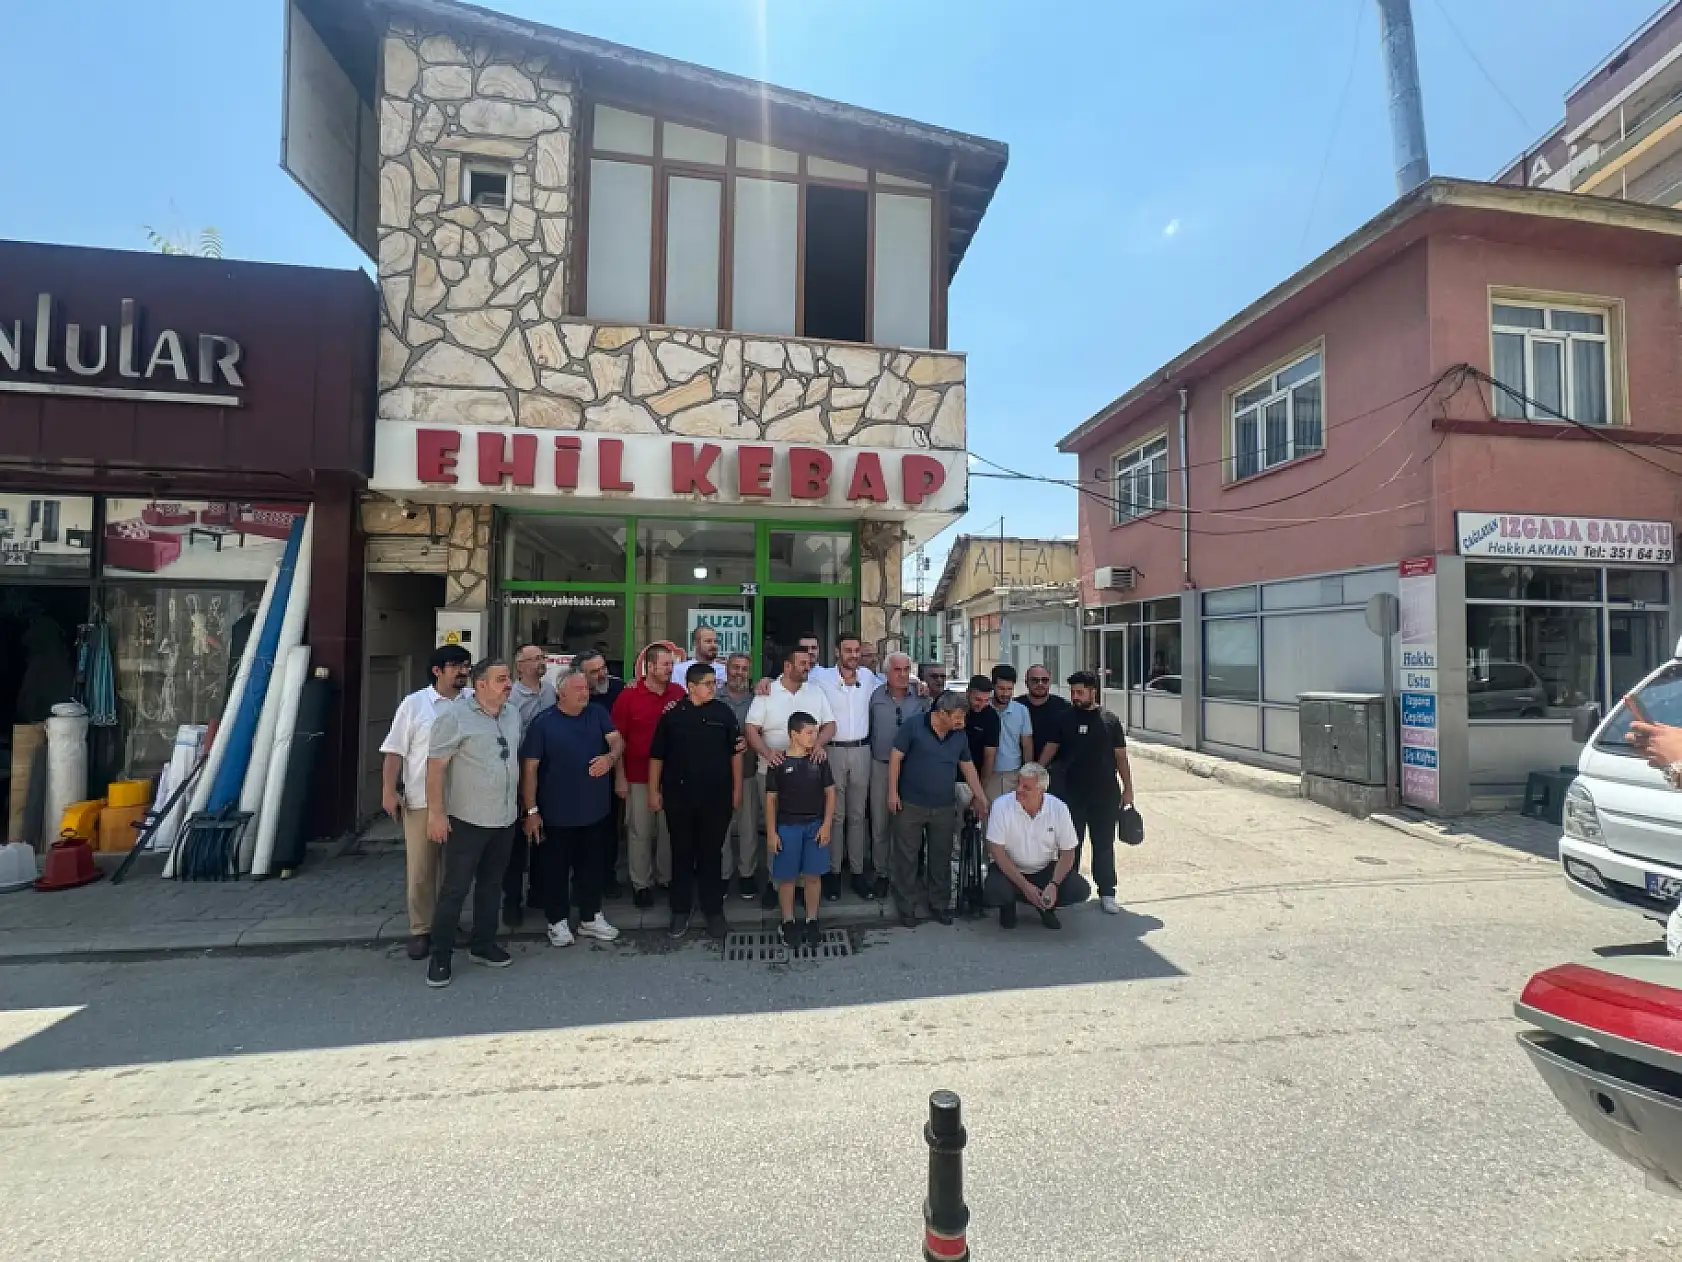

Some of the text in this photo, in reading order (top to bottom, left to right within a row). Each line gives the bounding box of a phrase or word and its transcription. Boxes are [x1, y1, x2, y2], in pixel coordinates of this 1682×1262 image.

[671, 441, 946, 505] KEBAP
[1587, 522, 1670, 545] SALONU
[1527, 543, 1578, 557] AKMAN
[1609, 547, 1633, 560] 351
[696, 613, 746, 627] KUZU
